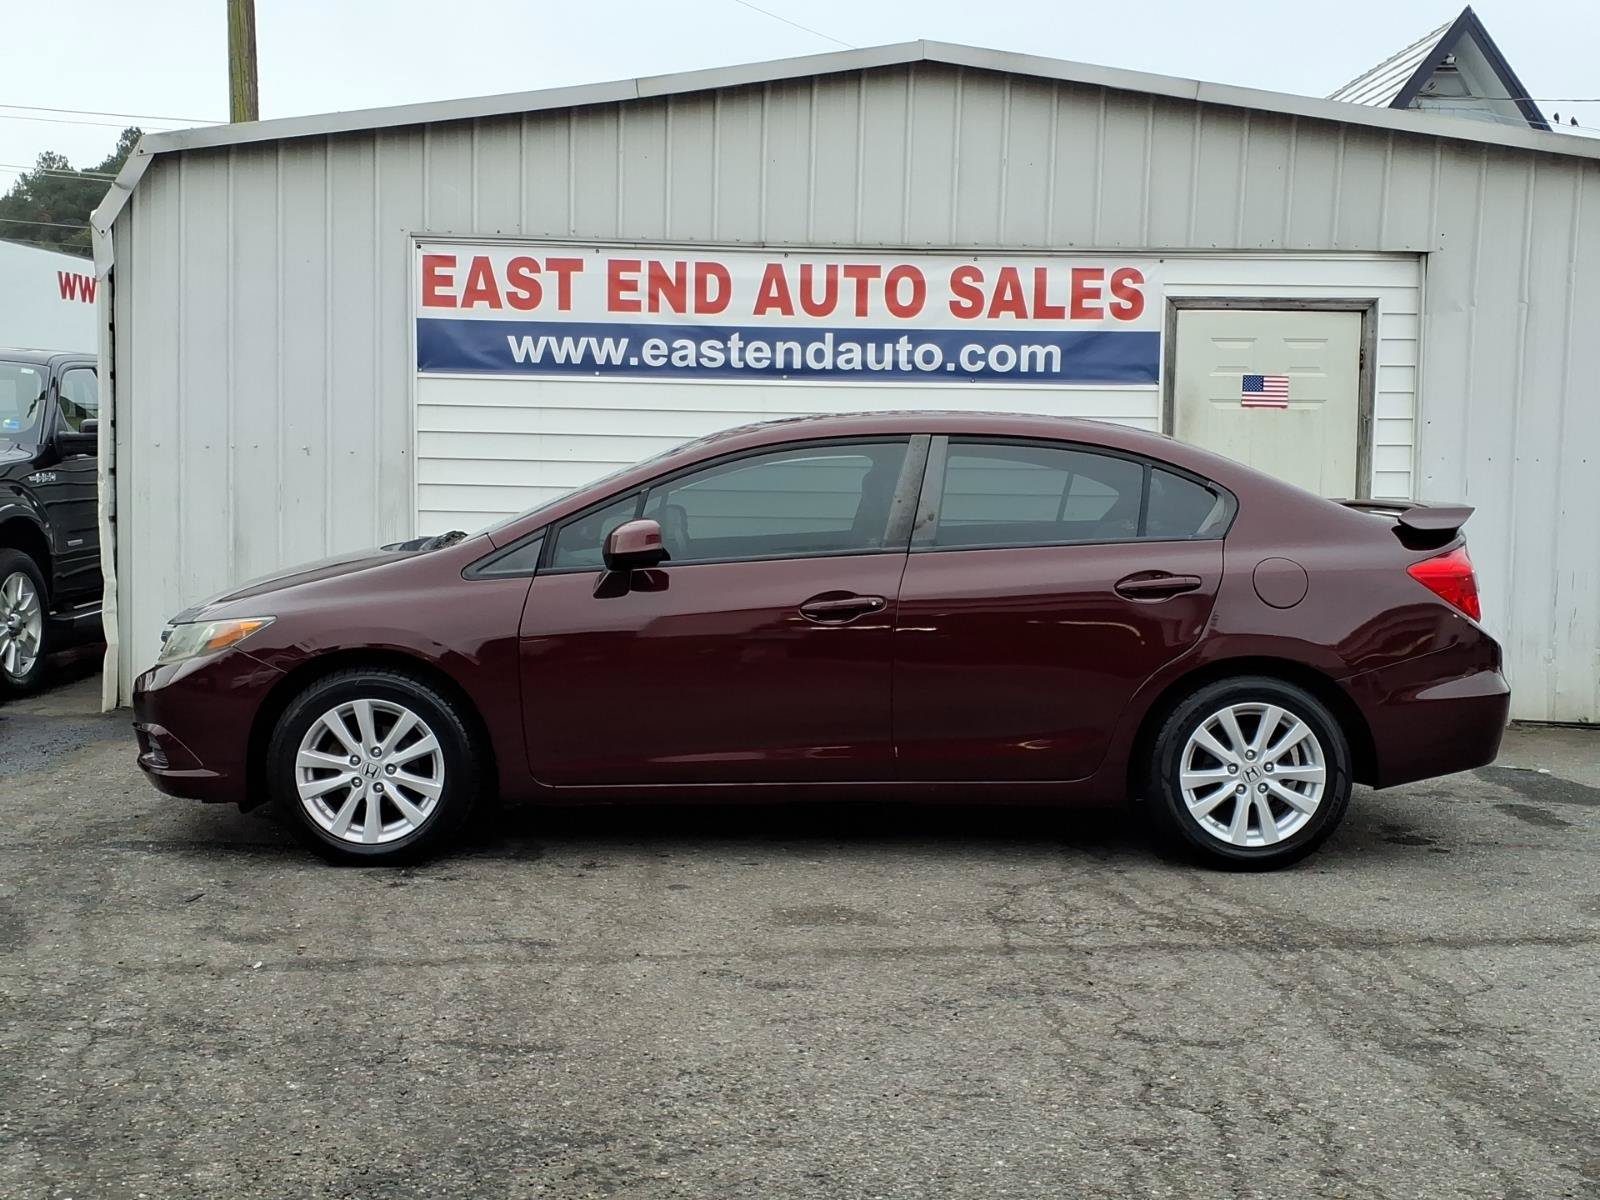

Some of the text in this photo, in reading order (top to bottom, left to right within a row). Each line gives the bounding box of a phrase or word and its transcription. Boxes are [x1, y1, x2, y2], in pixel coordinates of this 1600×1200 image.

[421, 254, 1146, 321] EAST END AUTO SALES
[506, 331, 1063, 373] www.eastendauto.com
